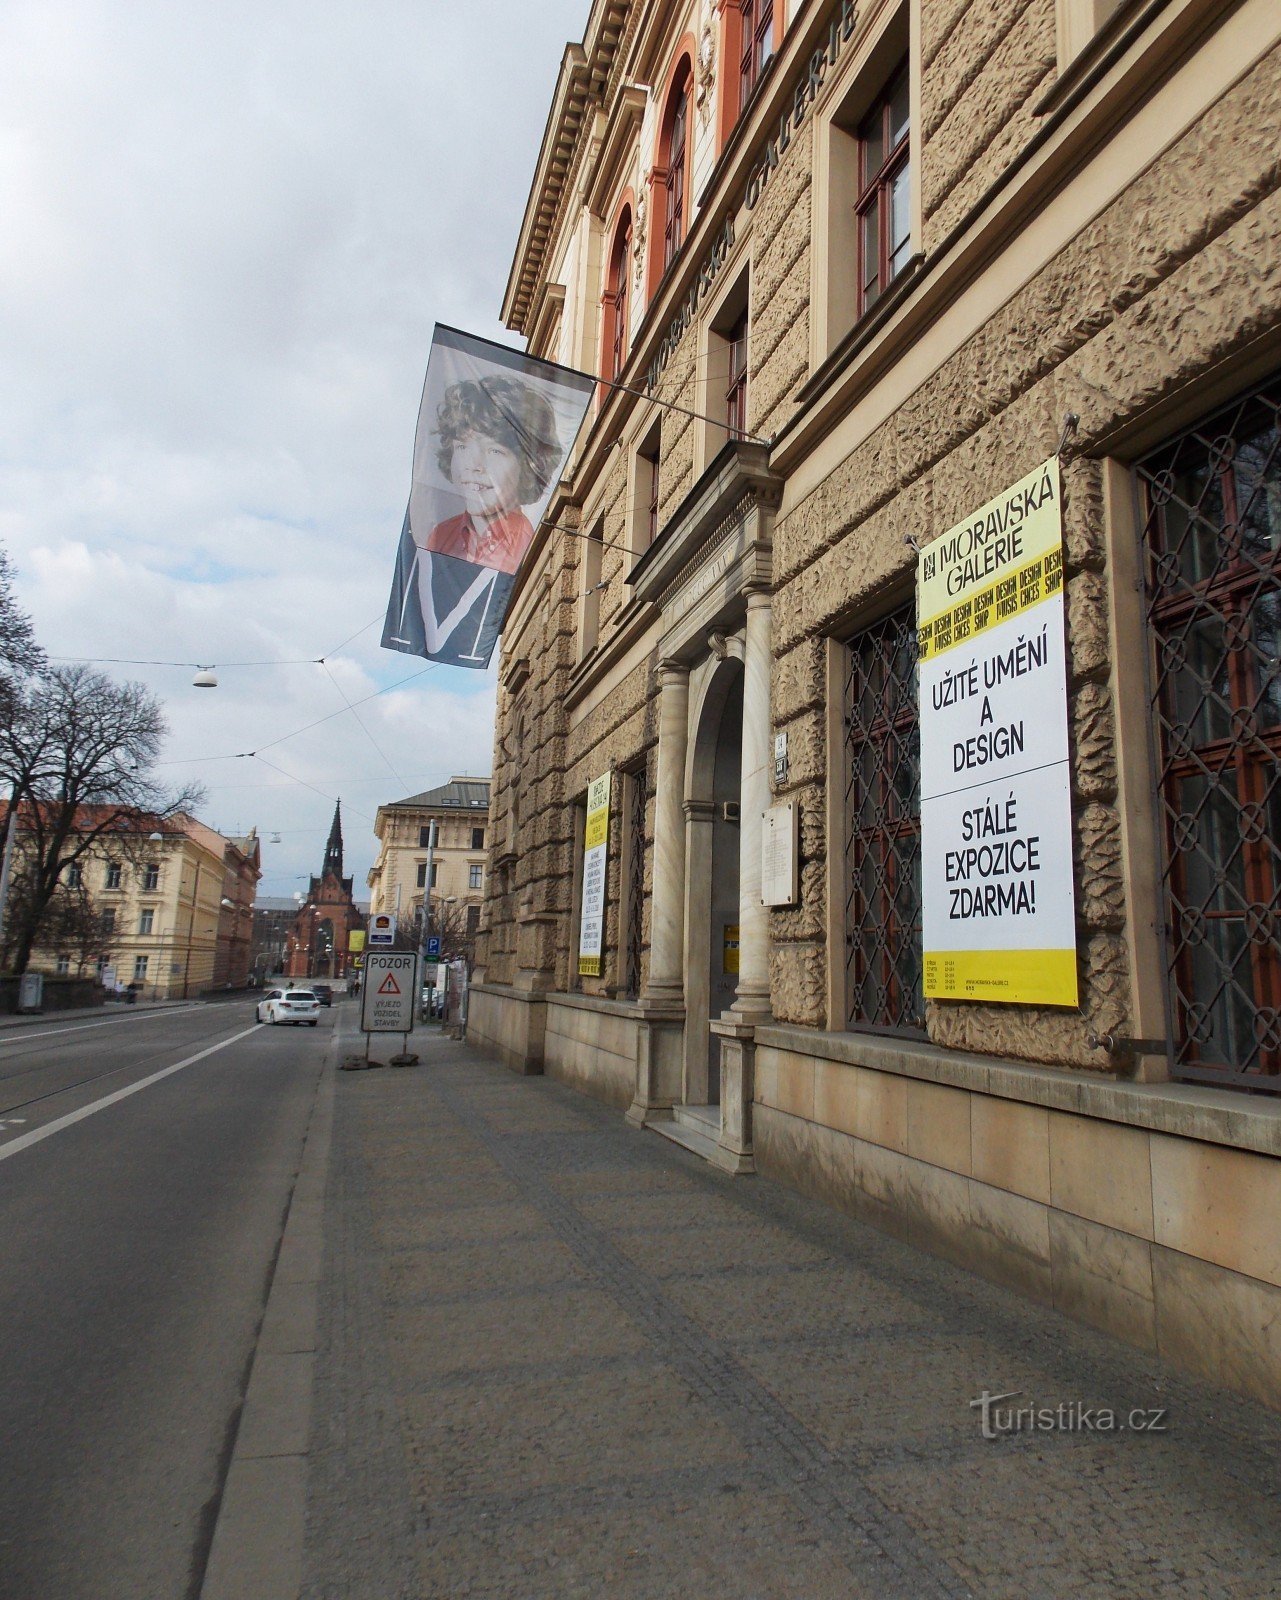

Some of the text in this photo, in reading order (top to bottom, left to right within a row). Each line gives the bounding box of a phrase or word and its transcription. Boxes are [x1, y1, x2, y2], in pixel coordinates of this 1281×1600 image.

[745, 0, 856, 211] GALERIE
[940, 466, 1054, 572] MORAVSKÁ
[946, 525, 1023, 597] GALERIE
[934, 612, 952, 636] DESIGN
[953, 601, 972, 625] DESIGN
[974, 588, 994, 614] DESIGN
[995, 575, 1017, 602] DESIGN
[1019, 561, 1042, 589] DESIGN
[932, 622, 1048, 711] UŽITÉ UMĚNÍ
[980, 695, 994, 727] A
[953, 720, 1024, 773] DESIGN
[962, 790, 1018, 842] STÁLÉ
[945, 836, 1040, 883] EXPOZICE
[950, 880, 1036, 920] ZDARMA!
[370, 957, 411, 969] POZOR
[373, 1010, 401, 1018] VOZIDEL
[374, 1019, 400, 1027] STAVBY
